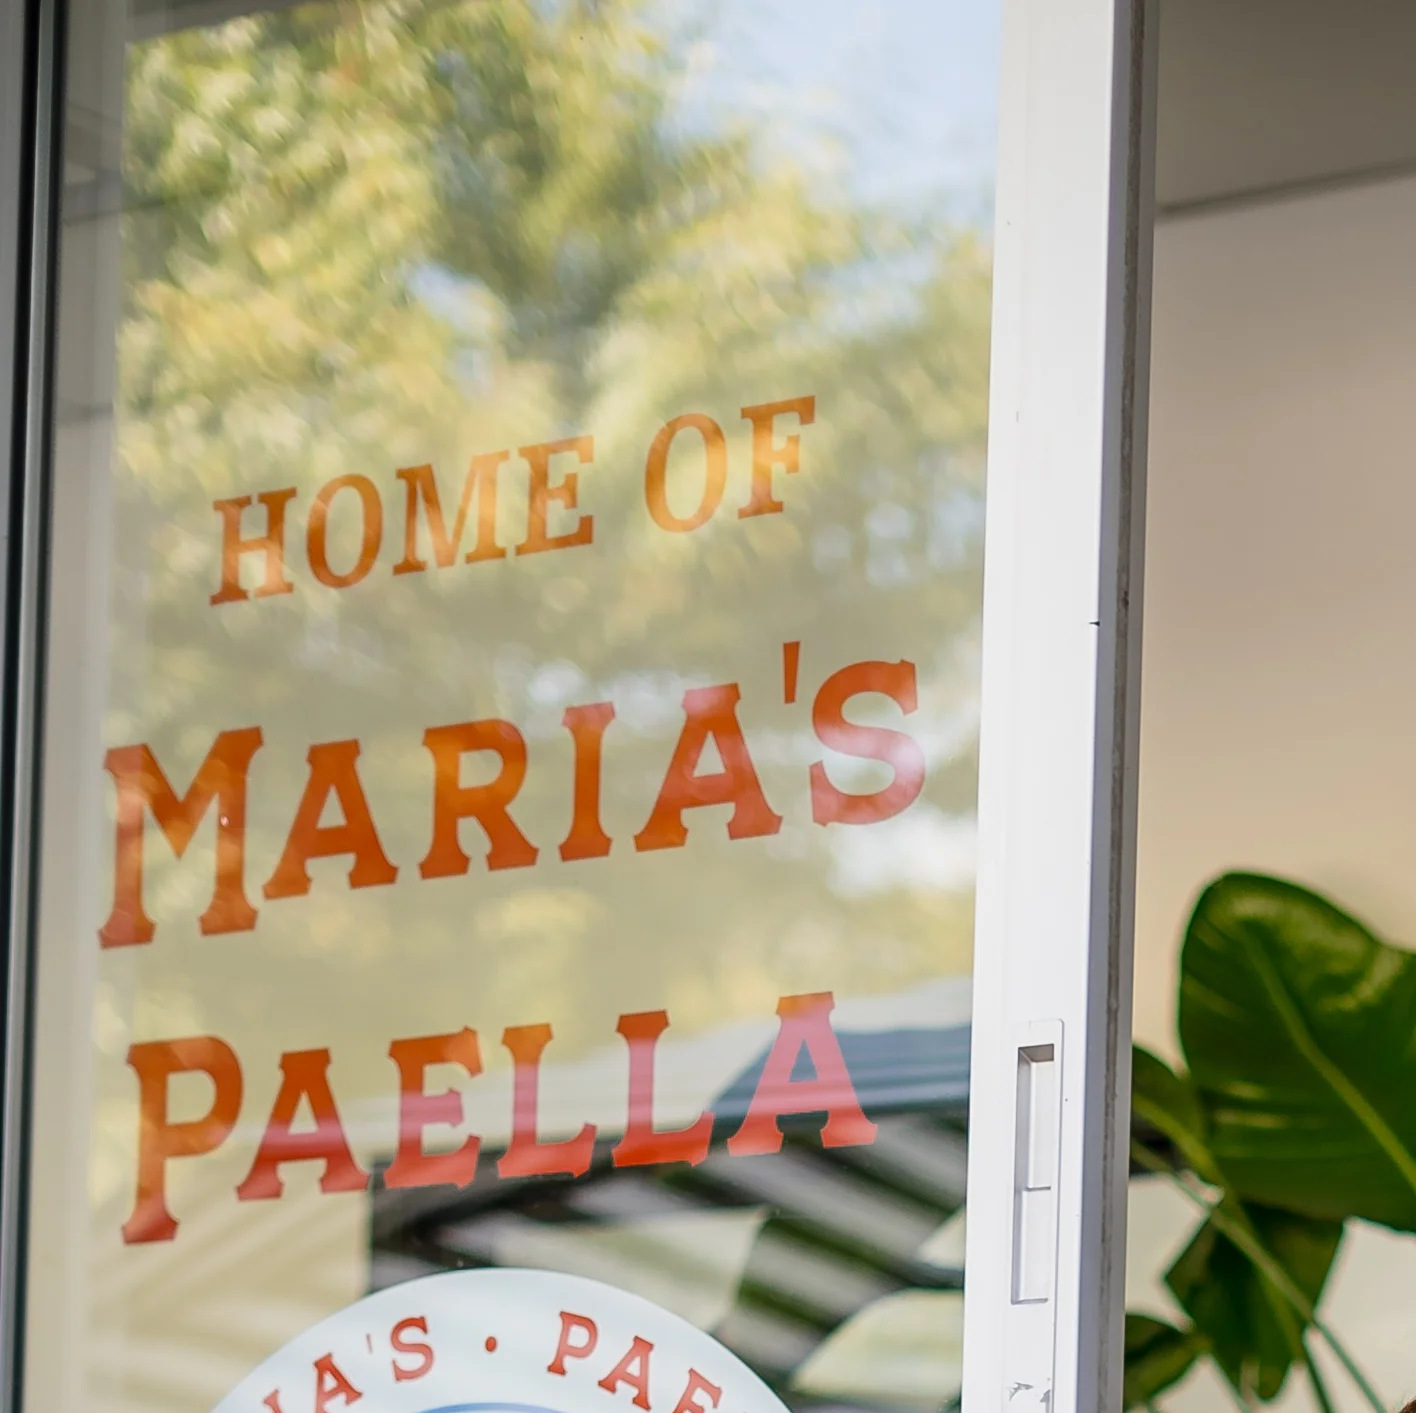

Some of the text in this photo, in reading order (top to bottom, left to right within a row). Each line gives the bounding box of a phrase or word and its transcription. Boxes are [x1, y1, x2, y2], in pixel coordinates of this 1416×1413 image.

[211, 395, 815, 605] HOME OF
[98, 641, 926, 949] MARIA'S
[122, 991, 878, 1245] PAELLA
